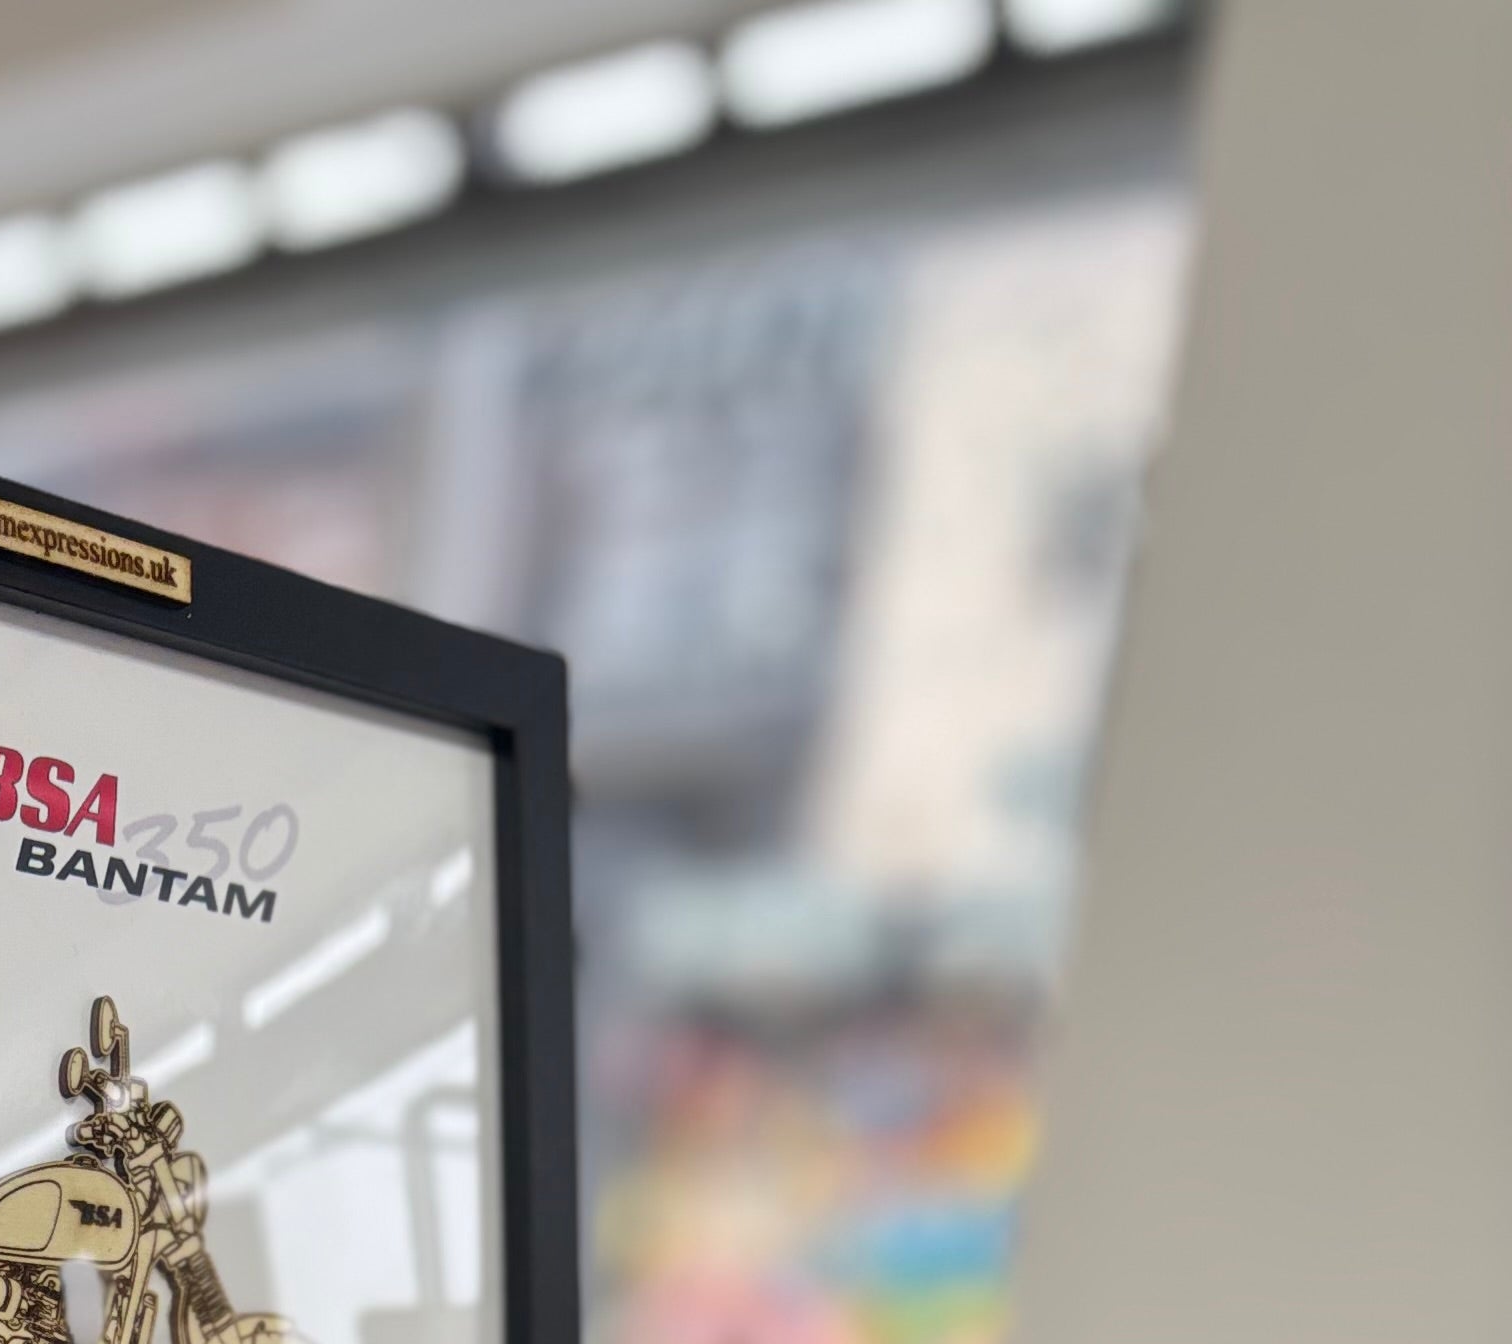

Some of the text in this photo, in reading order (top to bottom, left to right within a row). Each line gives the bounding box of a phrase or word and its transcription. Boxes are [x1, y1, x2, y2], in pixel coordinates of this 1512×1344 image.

[15, 837, 278, 924] BANTAM
[96, 803, 299, 906] 350
[80, 1203, 123, 1229] BSA
